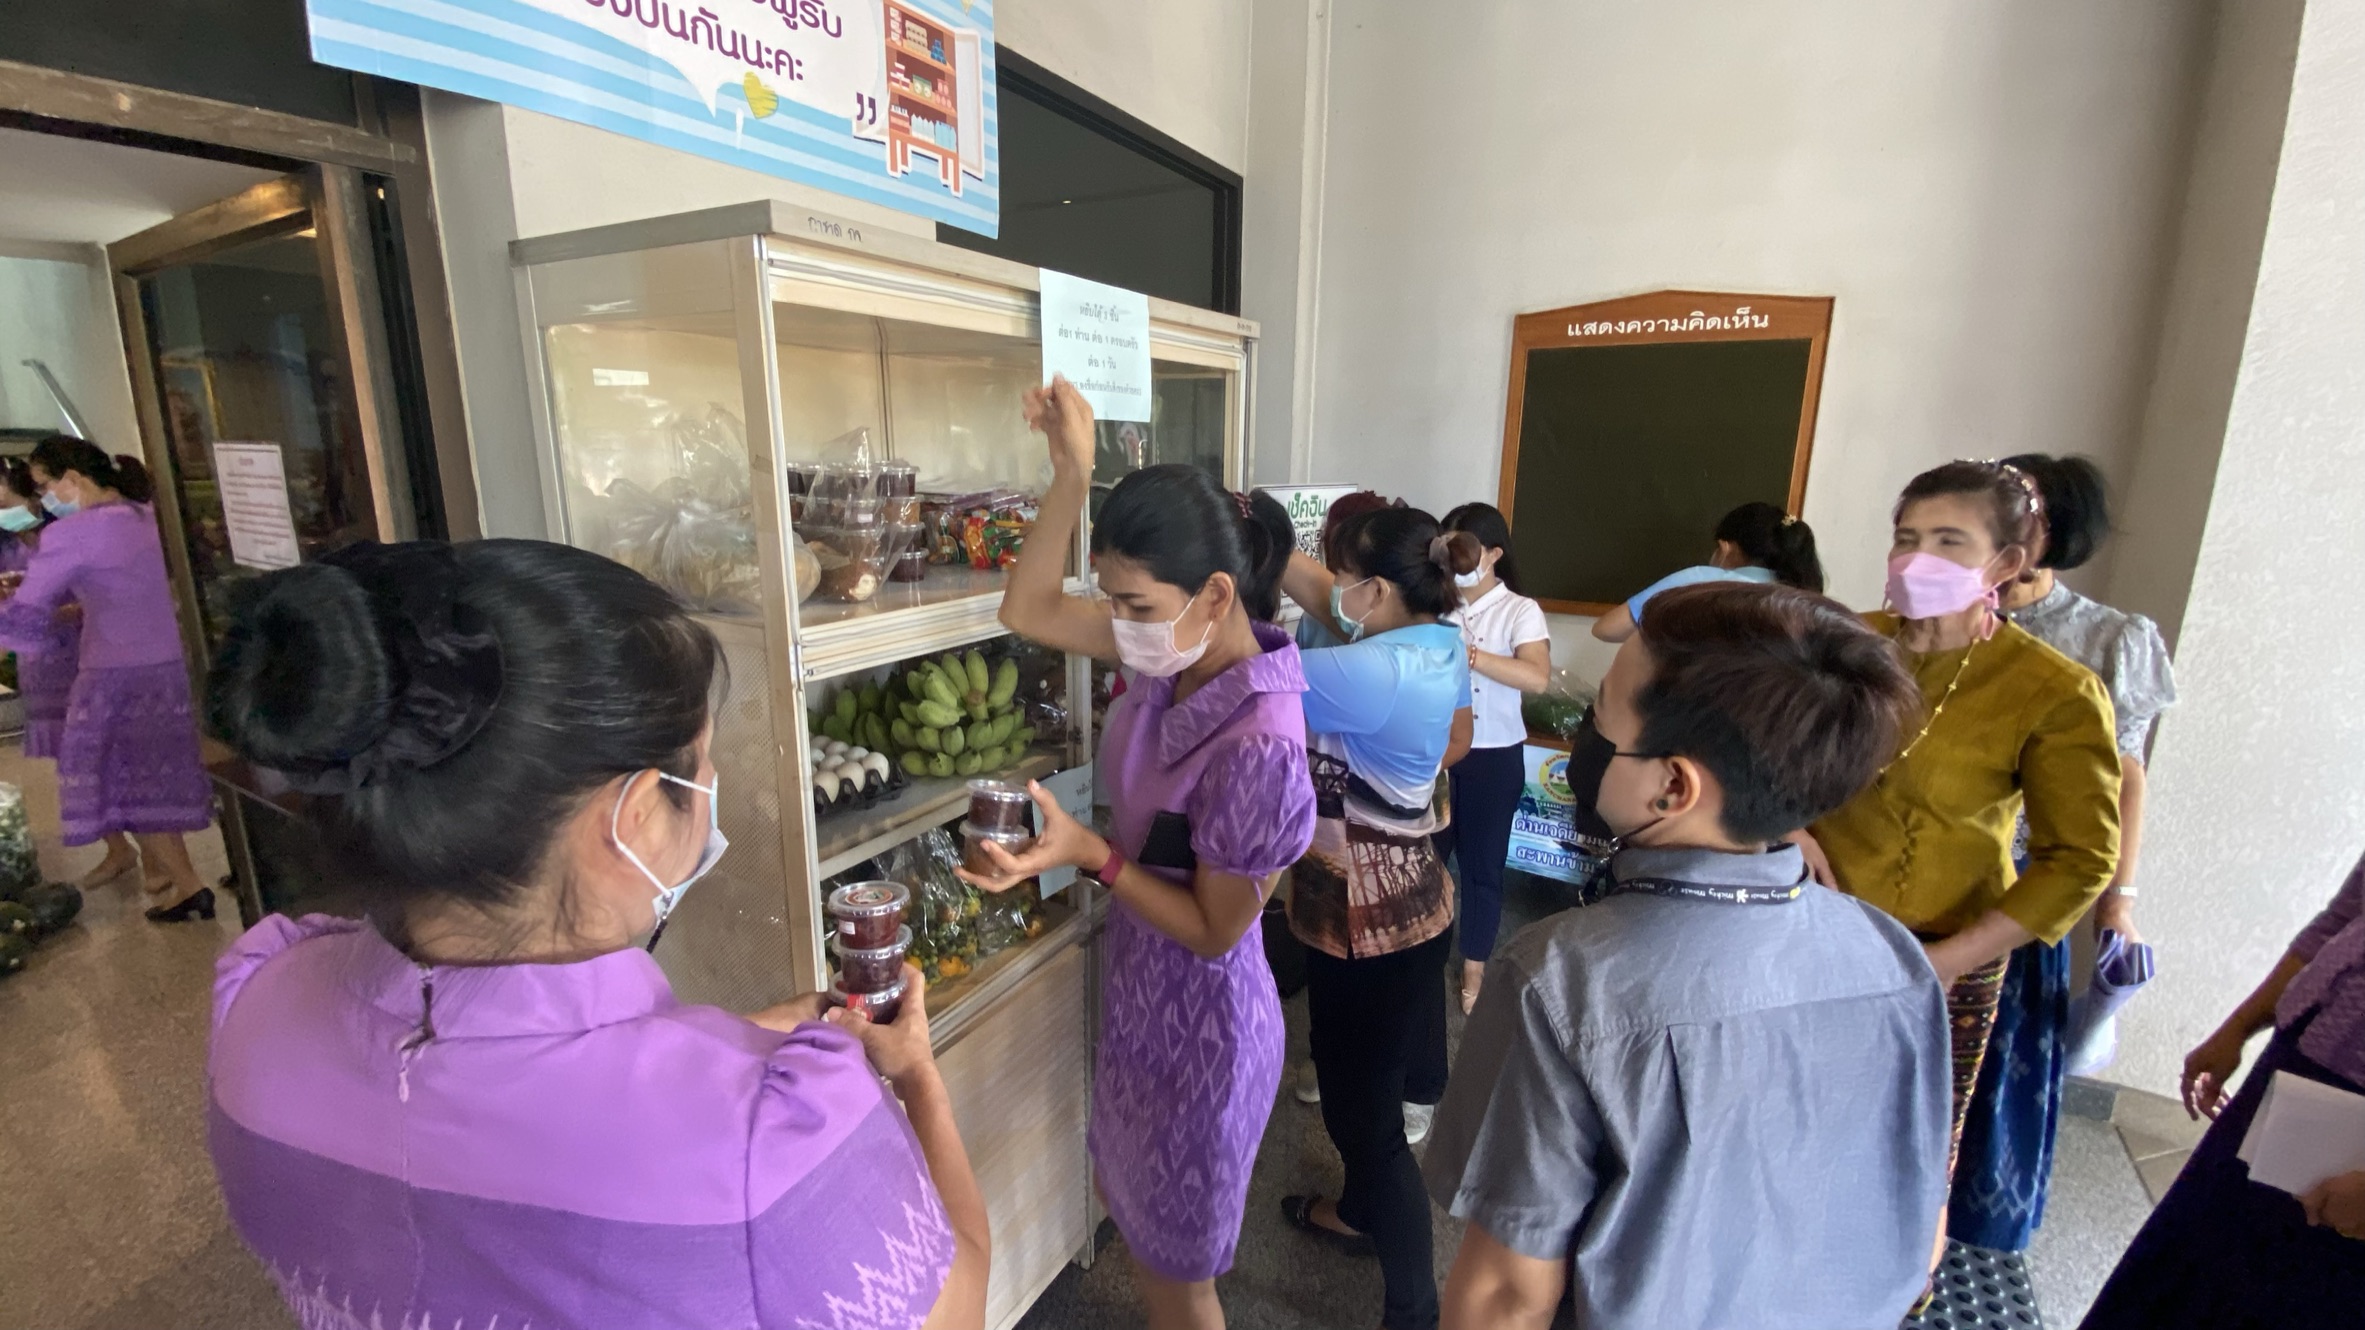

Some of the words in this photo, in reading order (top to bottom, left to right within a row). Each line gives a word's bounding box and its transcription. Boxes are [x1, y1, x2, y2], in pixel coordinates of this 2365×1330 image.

[1567, 306, 1770, 337] แสดงความคิดเห็น
[1074, 327, 1090, 342] ท่าน
[1092, 330, 1103, 344] ต่อ
[1110, 336, 1138, 350] ครอบครัว
[1087, 354, 1099, 368] ต่อ
[1108, 356, 1117, 369] วัน
